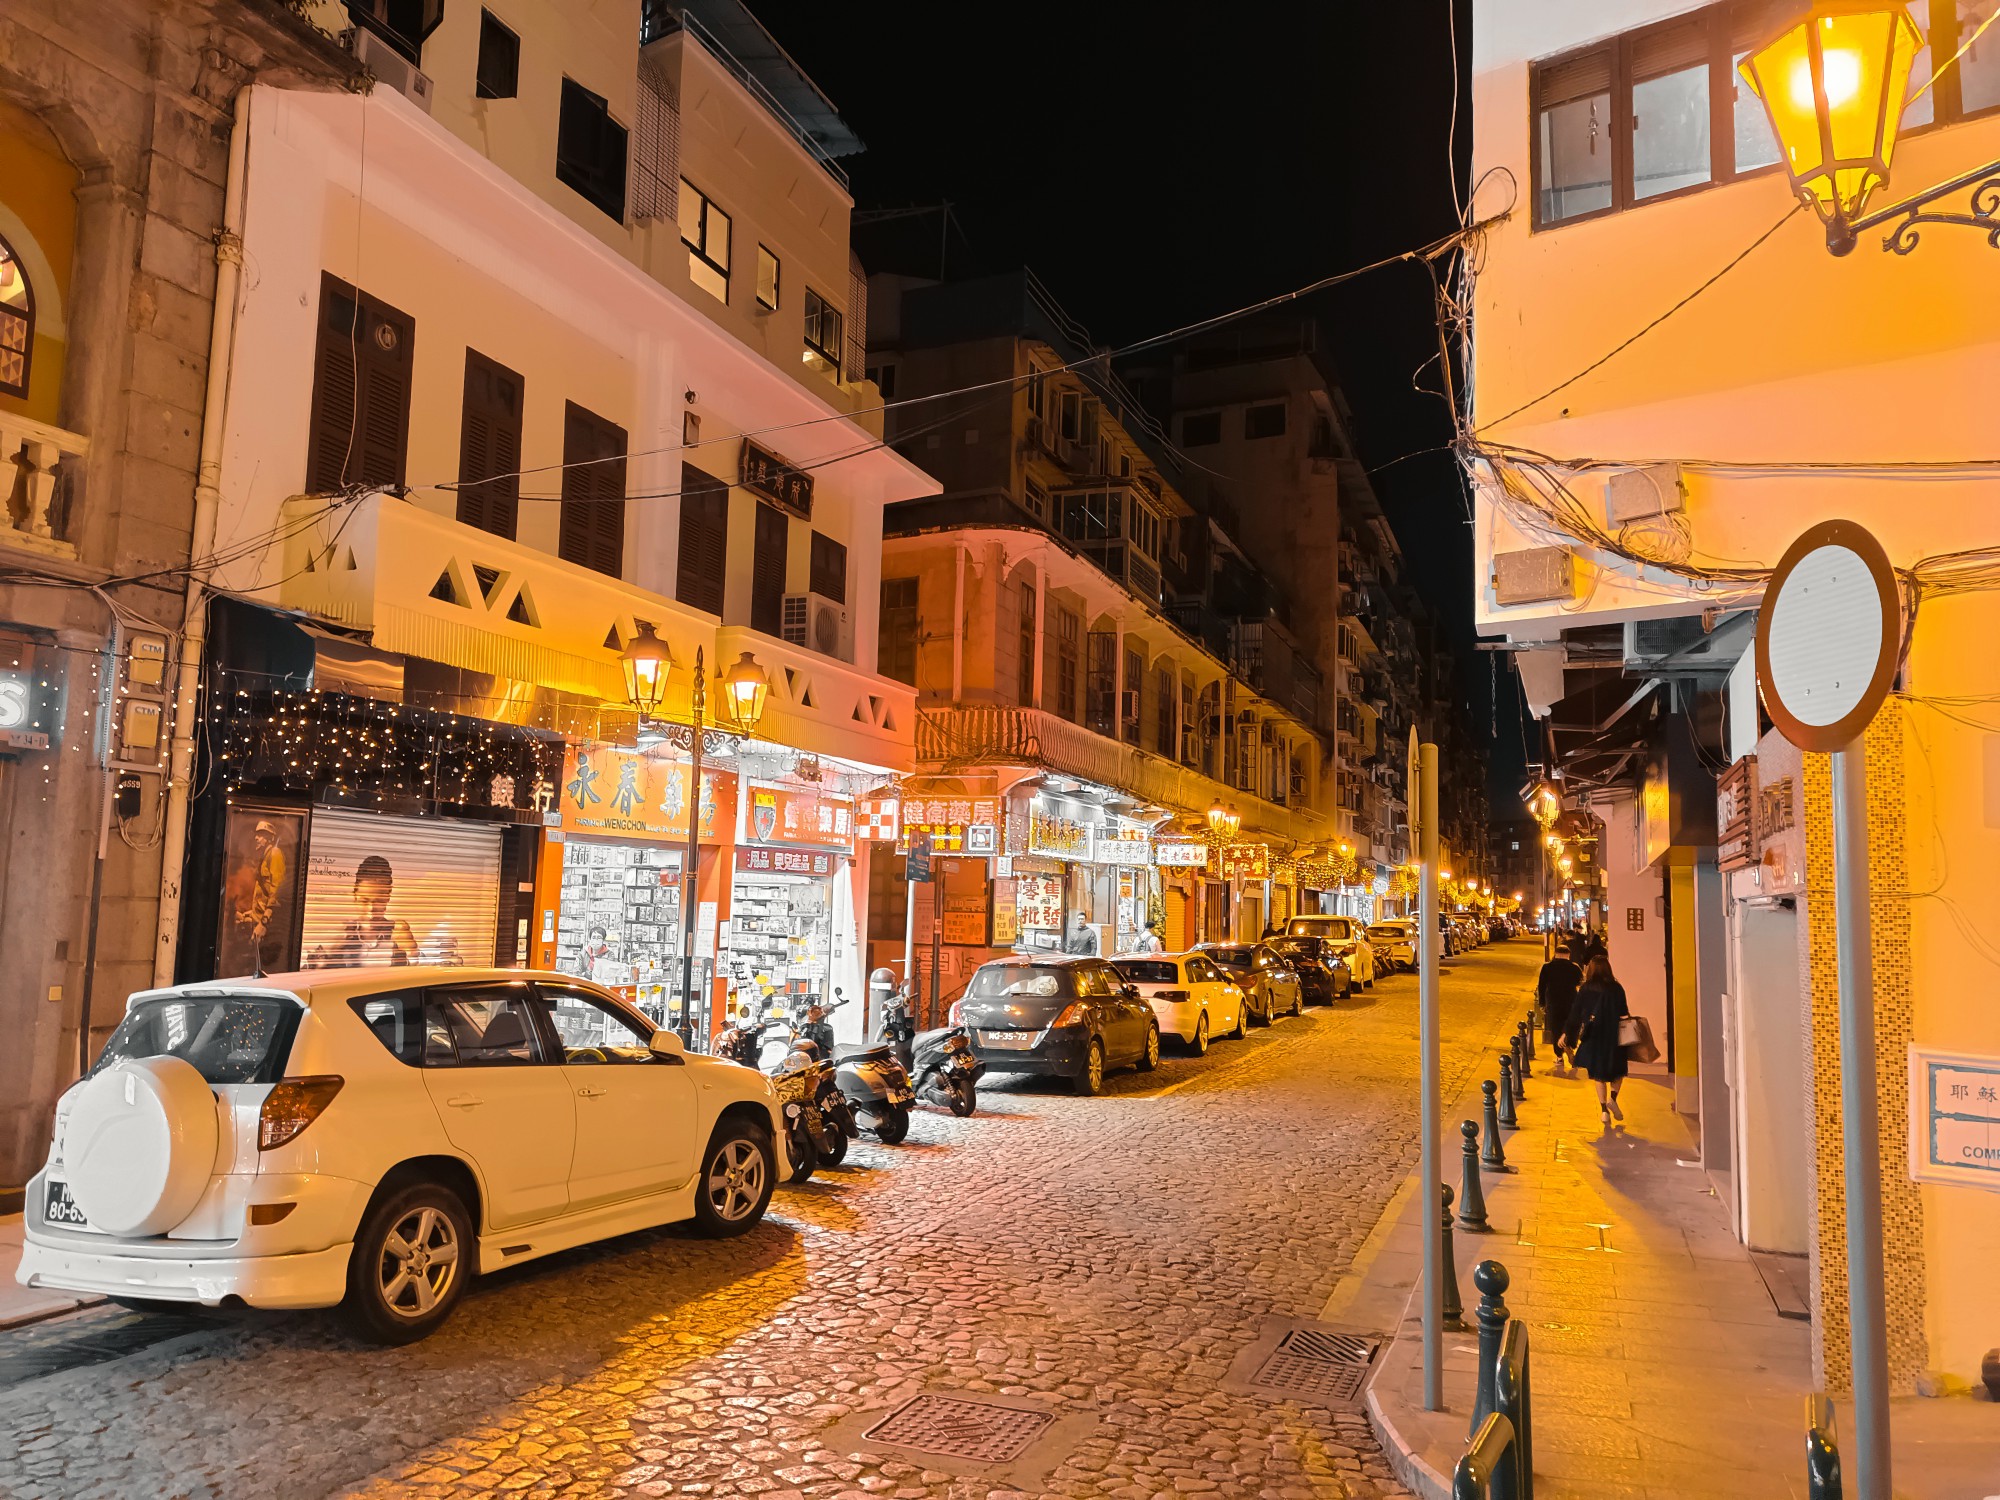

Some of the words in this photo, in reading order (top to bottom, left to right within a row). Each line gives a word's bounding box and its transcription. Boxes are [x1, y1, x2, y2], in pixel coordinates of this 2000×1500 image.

[141, 643, 162, 654] CTM
[134, 706, 156, 716] CTM
[1022, 881, 1060, 901] 零售
[1022, 905, 1061, 925] 批發
[1950, 1084, 1998, 1103] 耶穌
